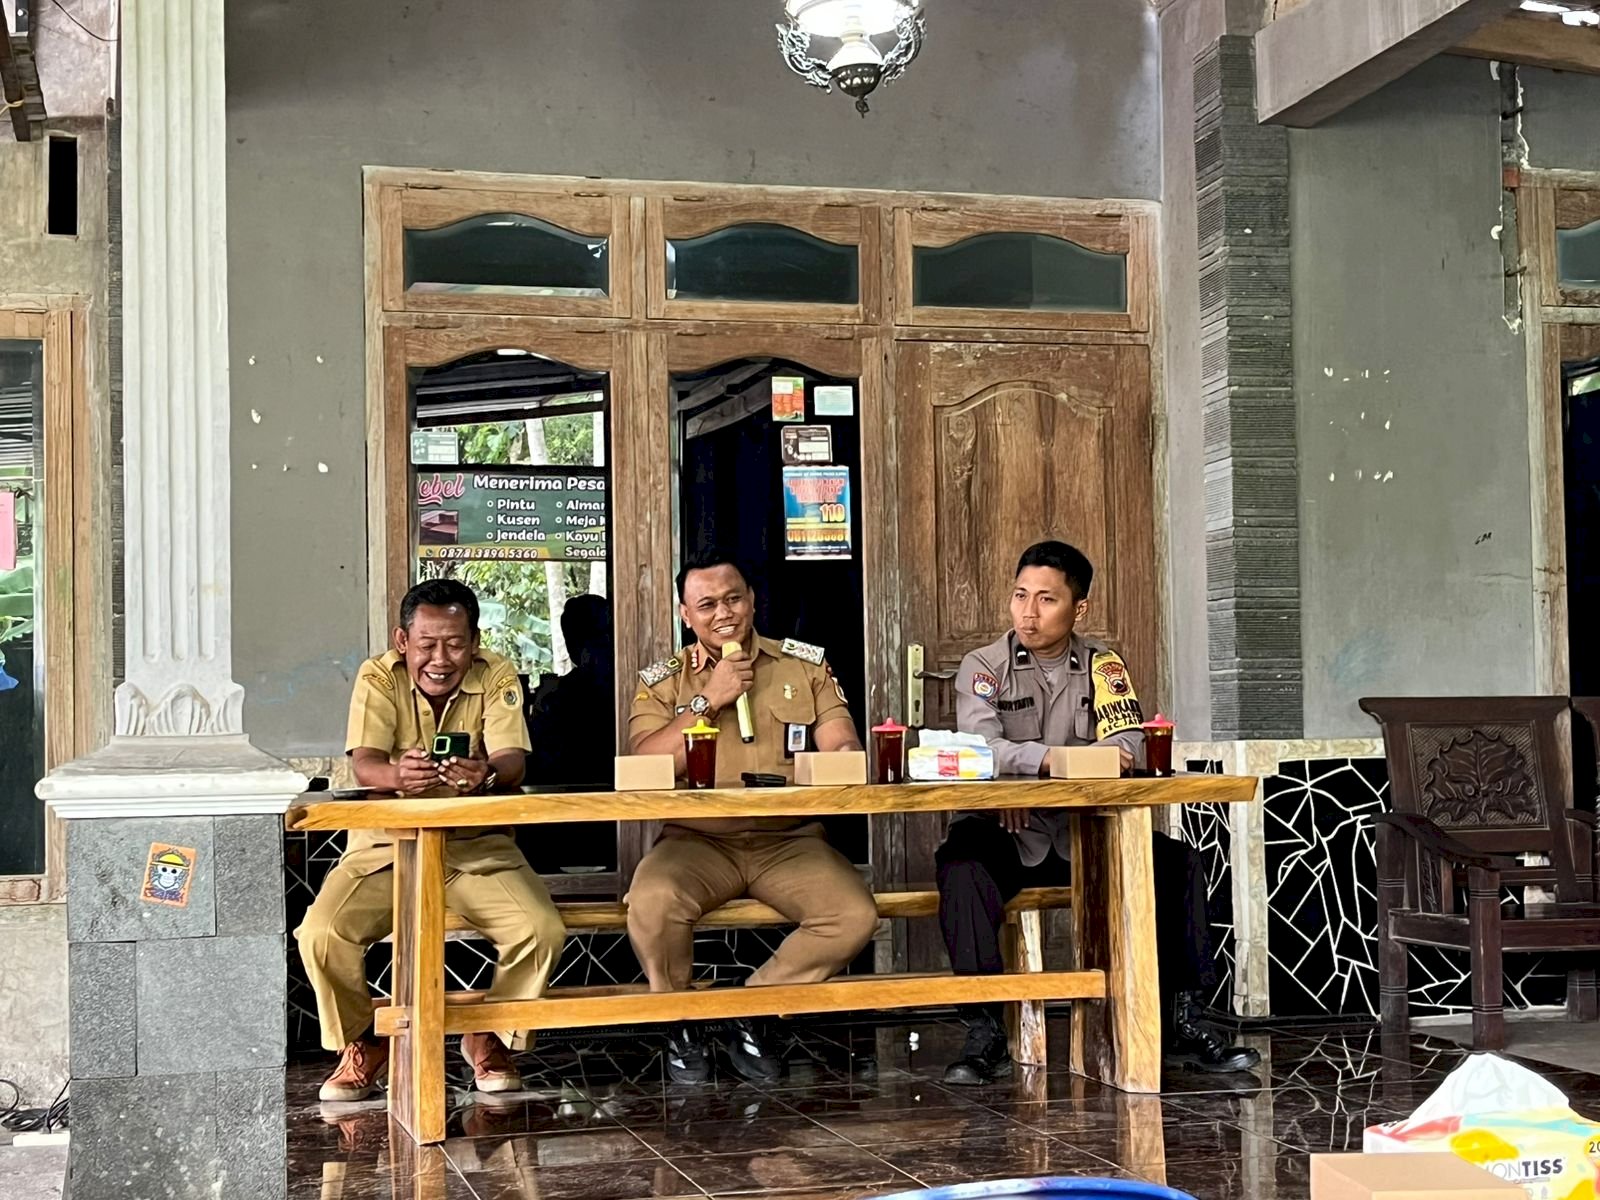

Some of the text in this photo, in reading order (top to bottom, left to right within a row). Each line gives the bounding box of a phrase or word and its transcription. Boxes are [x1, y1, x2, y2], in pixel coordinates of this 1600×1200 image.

[418, 473, 465, 497] ebel
[473, 475, 563, 490] Menerima
[497, 499, 535, 510] Pintu
[820, 503, 845, 522] 110
[497, 514, 540, 525] Kusen
[566, 515, 597, 527] Meja
[495, 529, 546, 543] Jendela
[566, 531, 599, 543] Kayu
[509, 548, 538, 559] 5360
[1486, 1158, 1563, 1179] ONTISS
